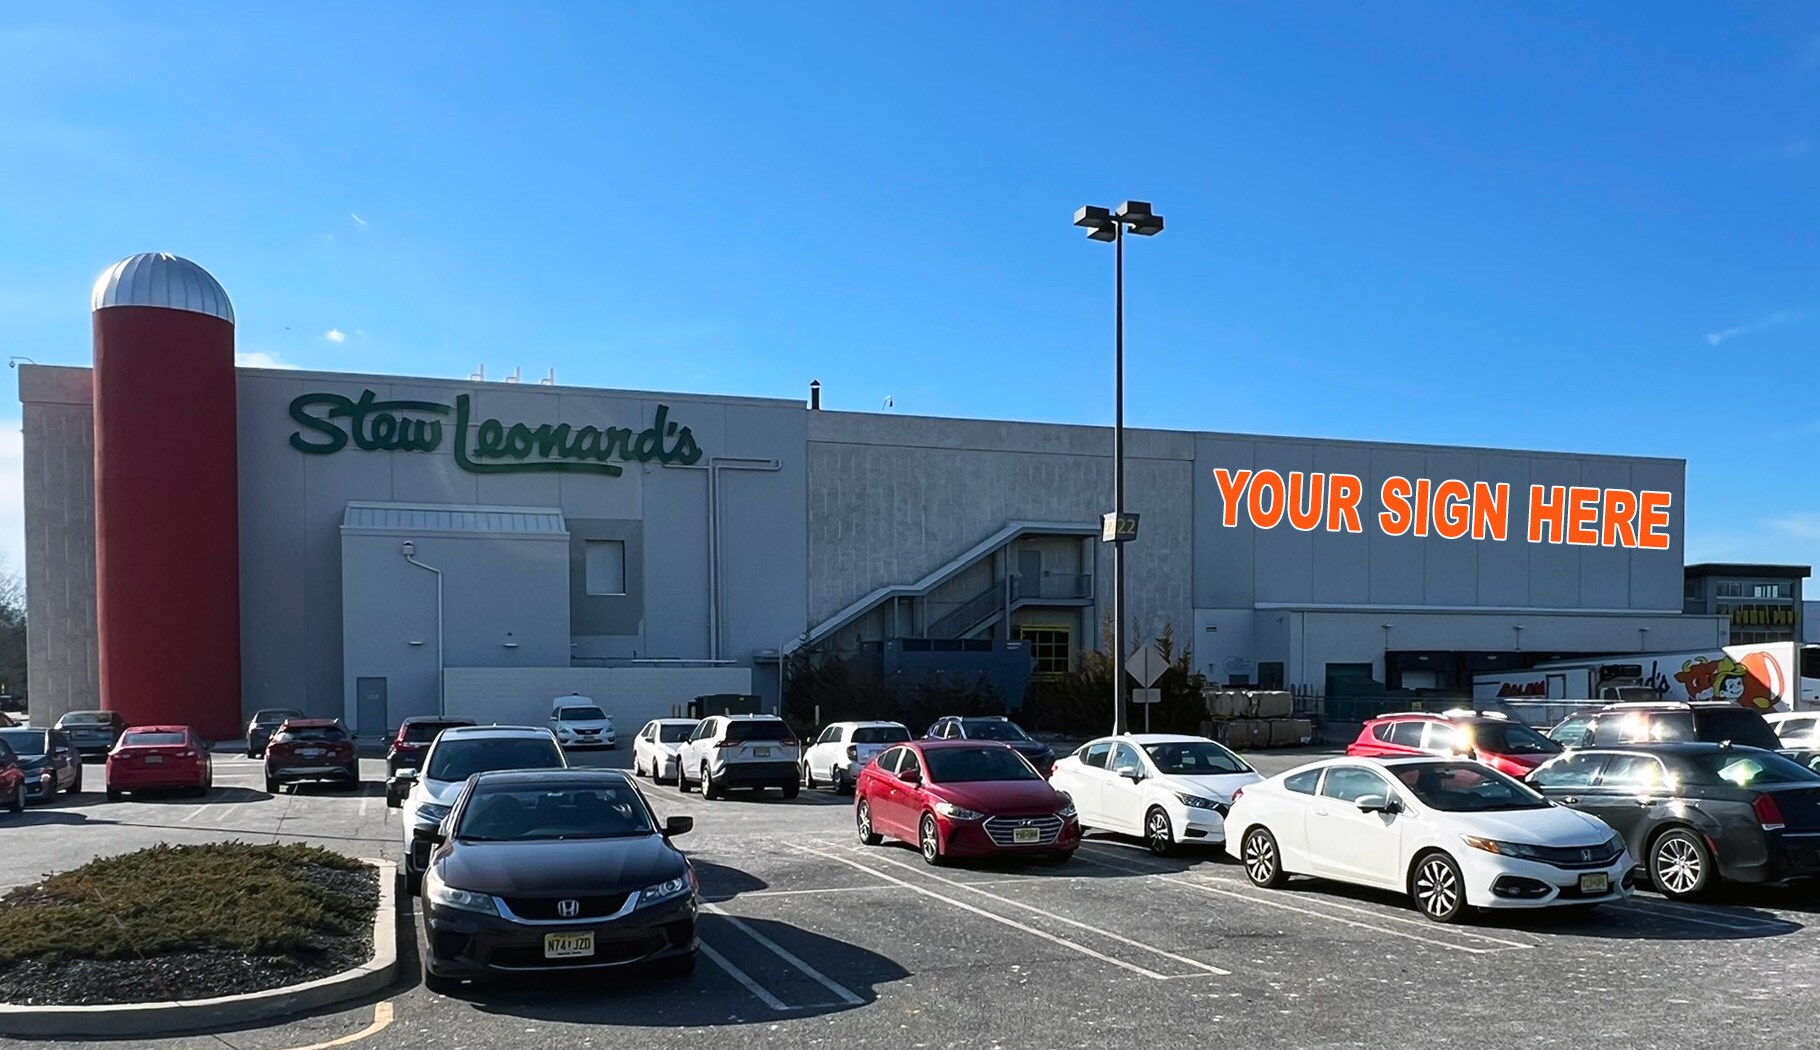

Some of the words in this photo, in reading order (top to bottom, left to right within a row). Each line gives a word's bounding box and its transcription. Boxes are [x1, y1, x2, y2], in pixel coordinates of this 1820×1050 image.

[290, 390, 452, 453] Stew
[454, 394, 702, 477] Leonard's
[1117, 518, 1136, 535] 22
